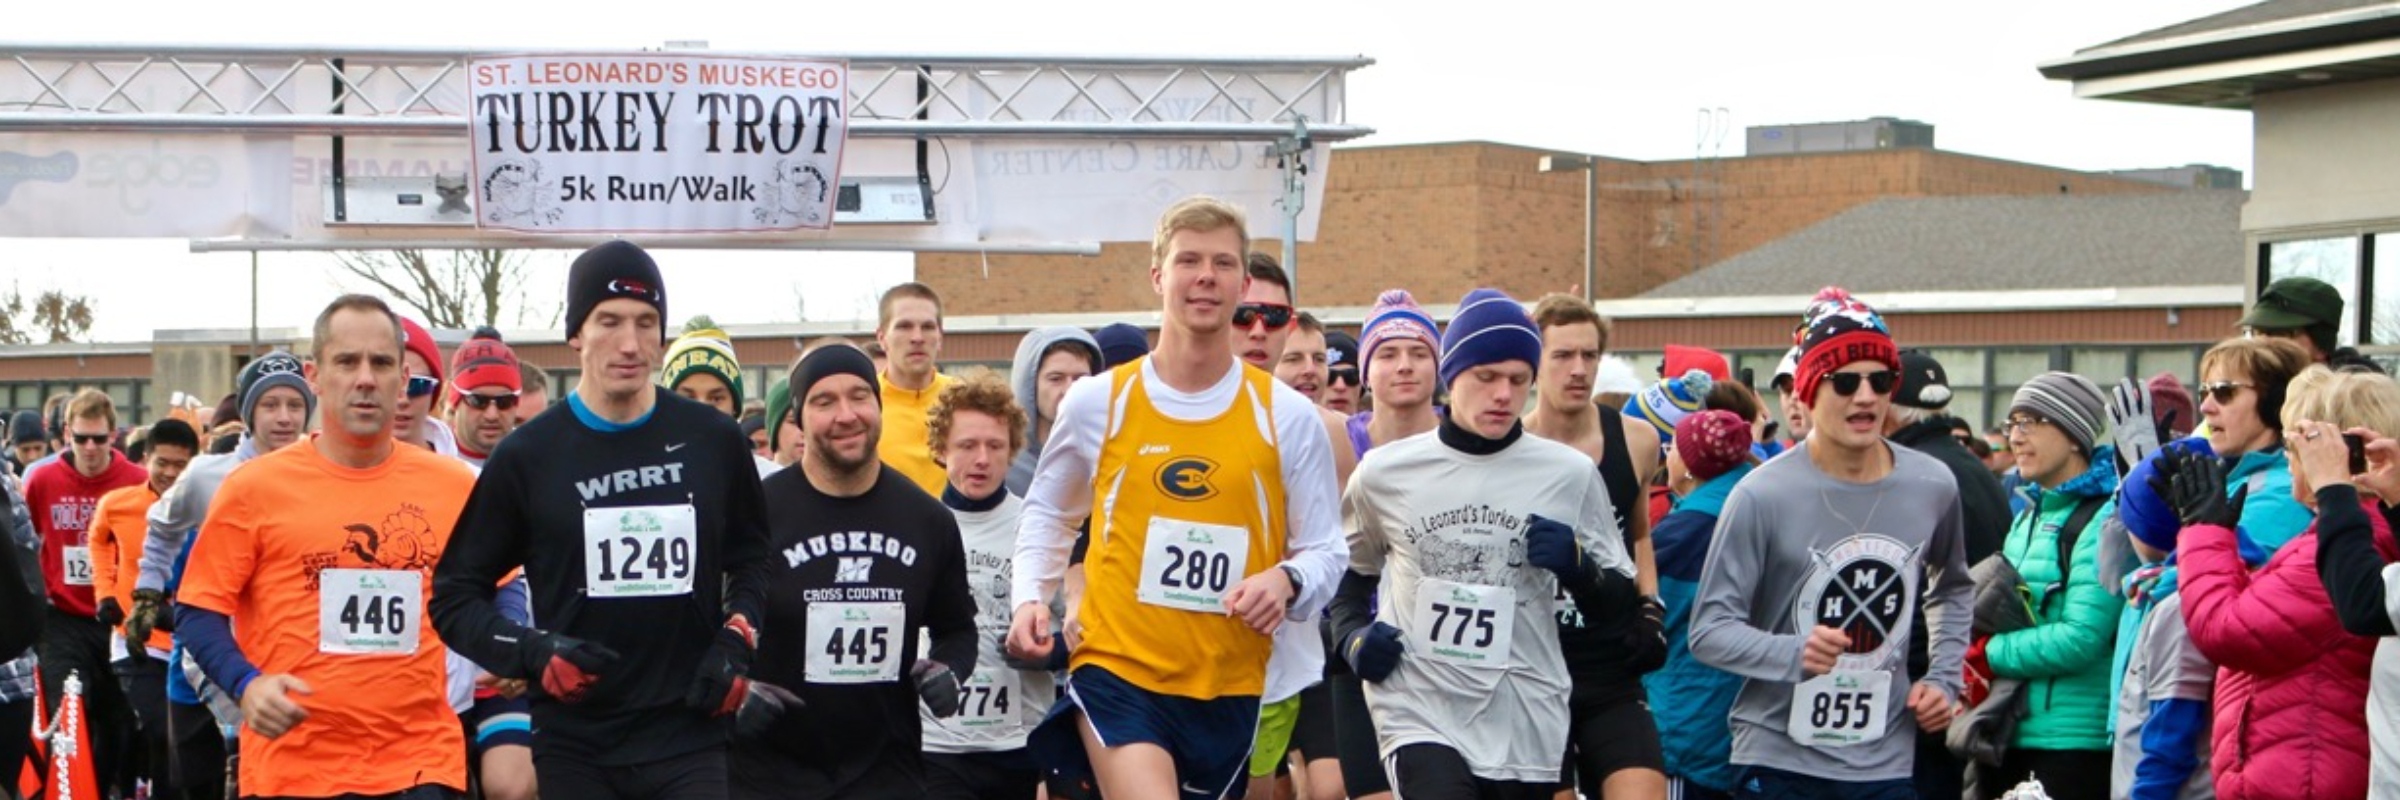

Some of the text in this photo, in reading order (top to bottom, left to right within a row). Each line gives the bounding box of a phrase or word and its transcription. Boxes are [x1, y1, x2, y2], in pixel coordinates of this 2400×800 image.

[477, 61, 838, 89] ST. LEONARD'S MUSKEGO
[477, 91, 840, 155] TURKEY TROT
[561, 175, 756, 204] 5k Run/Walk
[575, 462, 684, 500] WRRT
[1421, 504, 1477, 534] Leonard's
[1482, 504, 1520, 530] Turkey
[598, 537, 690, 581] 1249
[782, 531, 917, 569] MUSKEGO
[1160, 545, 1230, 592] 280
[803, 588, 903, 602] CROSS COUNTRY
[1852, 568, 1878, 589] M
[340, 595, 405, 634] 446
[1824, 593, 1898, 618] H S
[1430, 602, 1495, 648] 775
[826, 627, 889, 664] 445
[957, 685, 1009, 717] 774
[1811, 692, 1872, 729] 855
